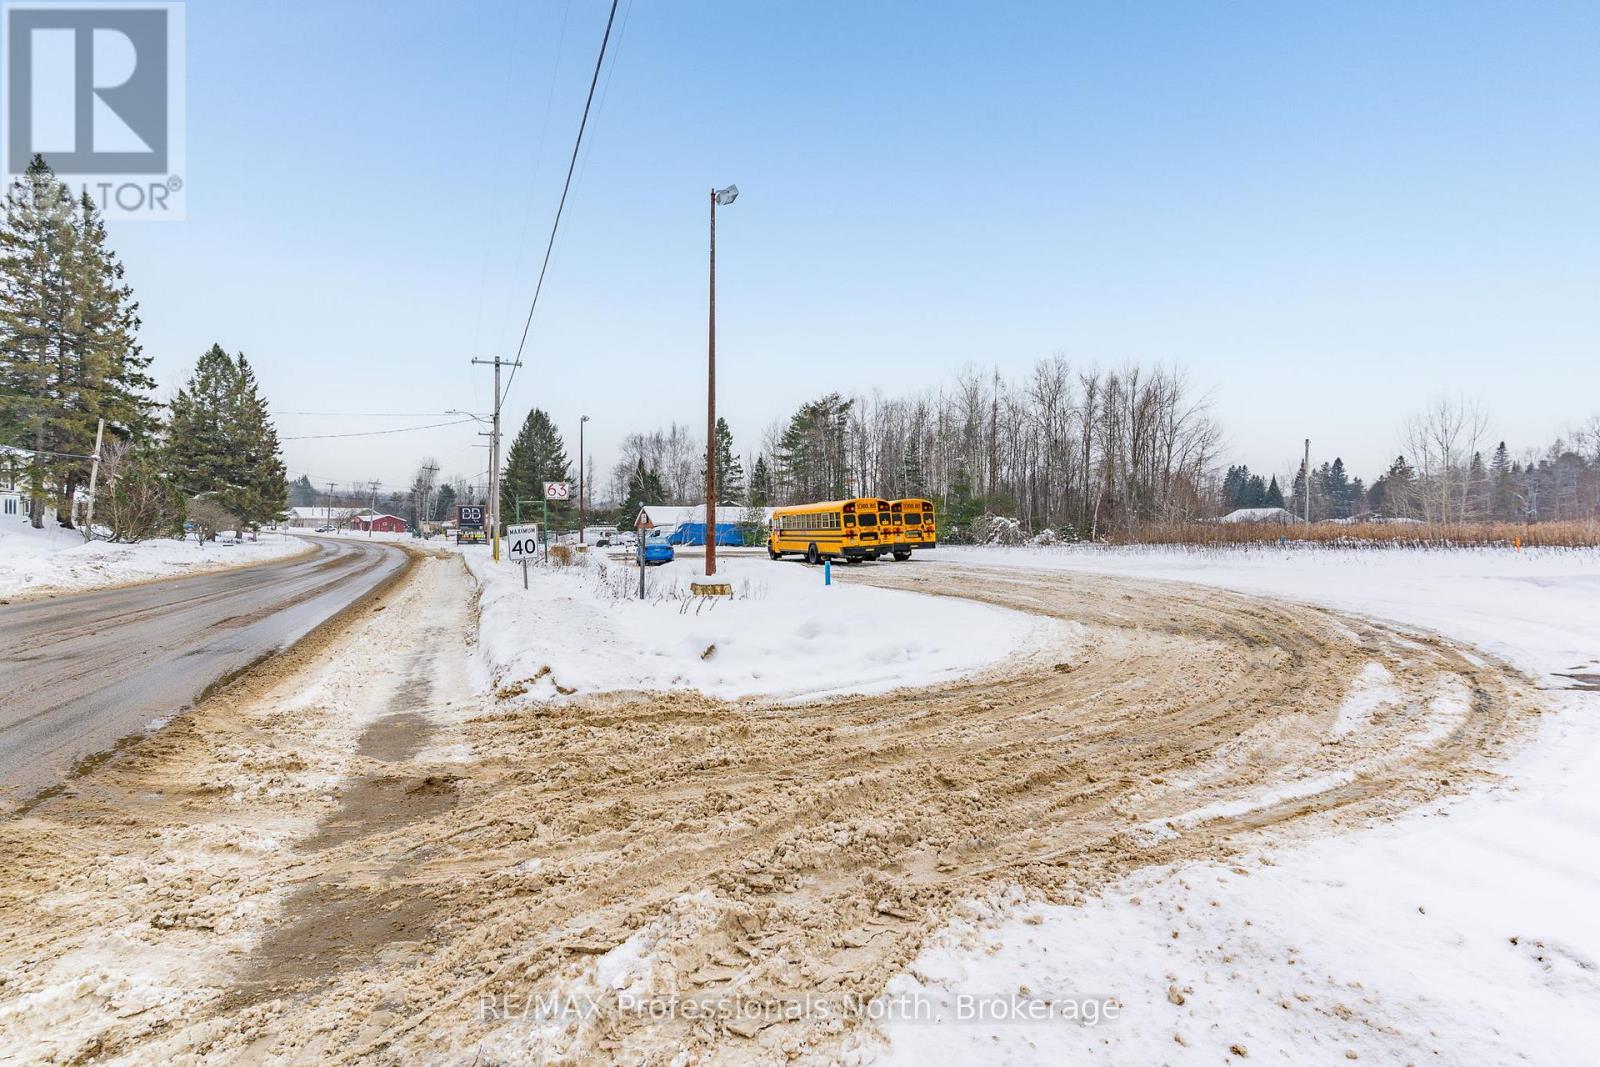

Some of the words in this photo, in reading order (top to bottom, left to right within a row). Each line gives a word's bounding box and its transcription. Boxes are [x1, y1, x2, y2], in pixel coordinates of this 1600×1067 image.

[548, 483, 567, 496] 63
[509, 527, 536, 535] MAXIMUM
[512, 539, 535, 554] 40
